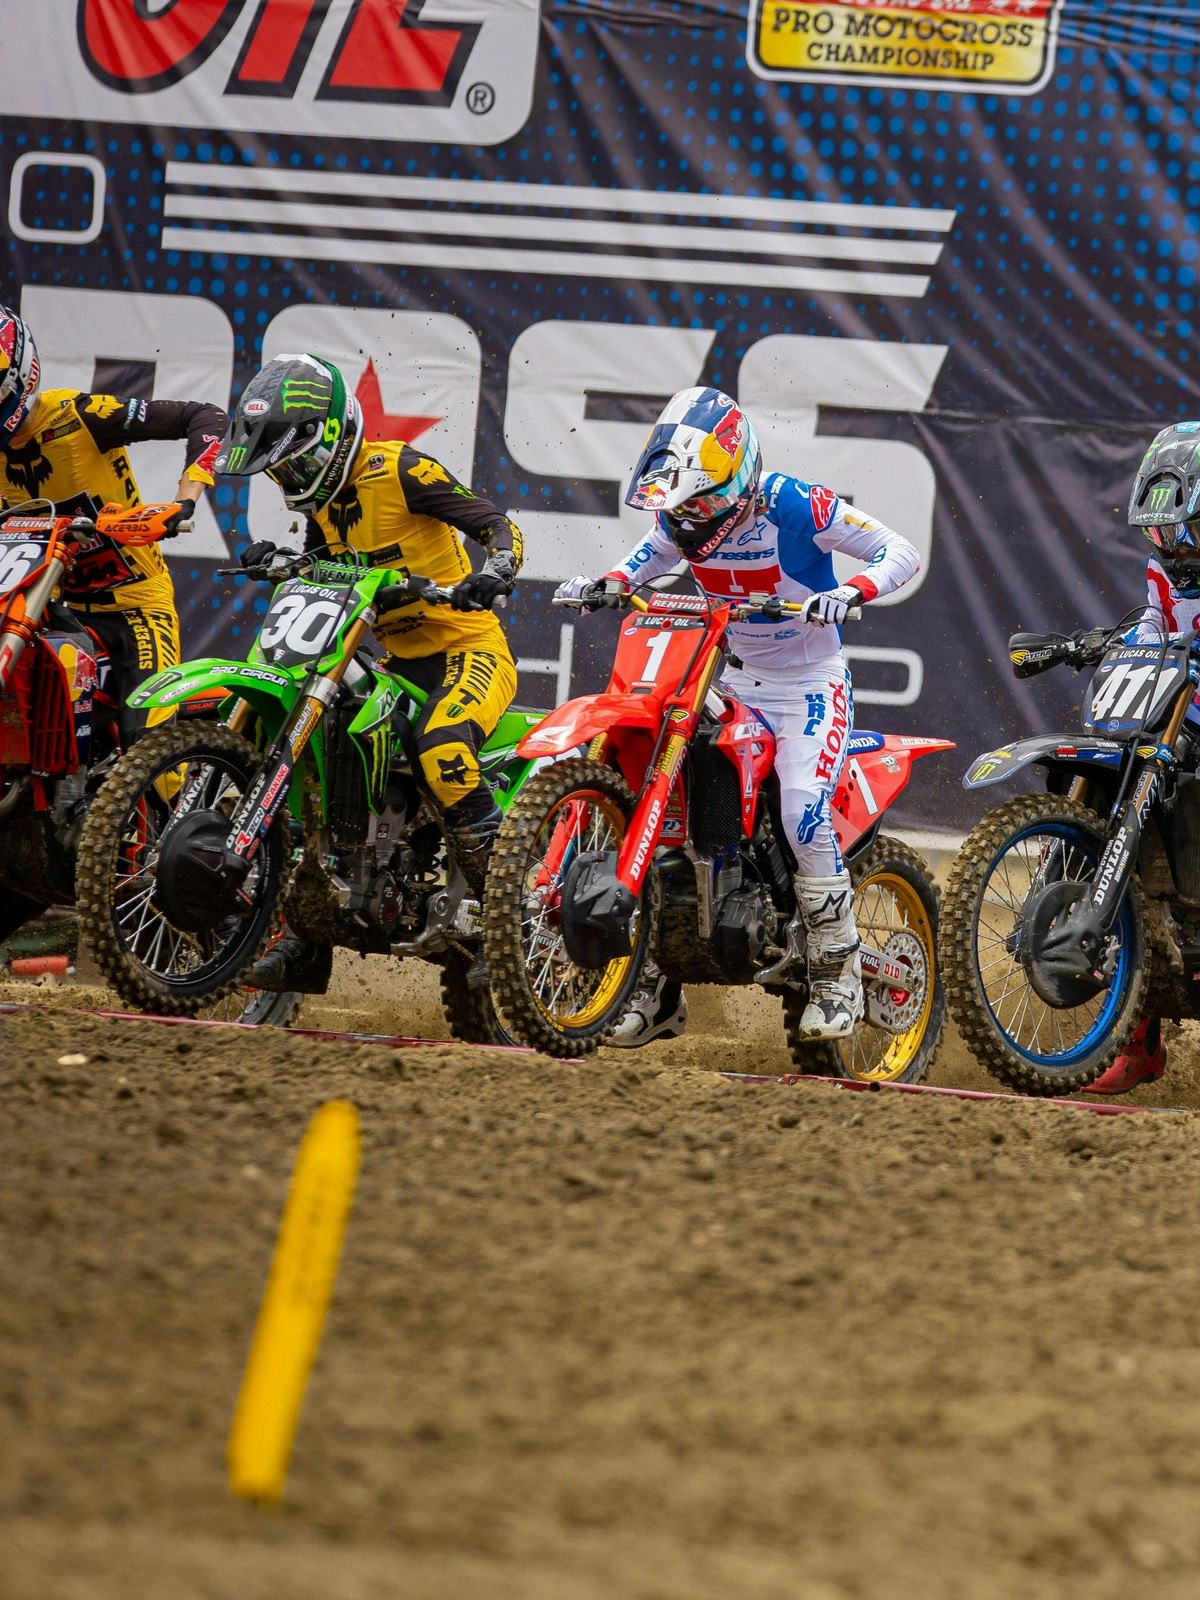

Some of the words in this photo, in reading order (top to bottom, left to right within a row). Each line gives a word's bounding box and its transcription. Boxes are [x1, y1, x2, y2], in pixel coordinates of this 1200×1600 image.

[771, 9, 834, 34] PRO
[844, 13, 1034, 47] MOTOCROSS
[807, 42, 994, 71] CHAMPIONSHIP
[247, 403, 264, 411] BELL
[645, 498, 665, 508] Bull
[1135, 512, 1176, 520] MONSTER
[104, 523, 150, 533] ACERBIS
[0, 543, 42, 593] 6
[290, 584, 320, 597] LUCAS
[319, 588, 338, 600] OIL
[260, 594, 346, 655] 30
[675, 617, 689, 627] OIL
[641, 631, 673, 682] 1
[1118, 649, 1144, 660] LUCAS
[1144, 650, 1161, 660] OIL
[1092, 663, 1179, 720] 411
[803, 693, 827, 736] HRC
[815, 681, 847, 783] HONDA
[261, 764, 289, 809] BRAKING
[848, 756, 879, 816] 1
[226, 772, 266, 849] DUNLOP
[629, 799, 661, 881] DUNLOP
[1093, 826, 1127, 906] DUNLOP
